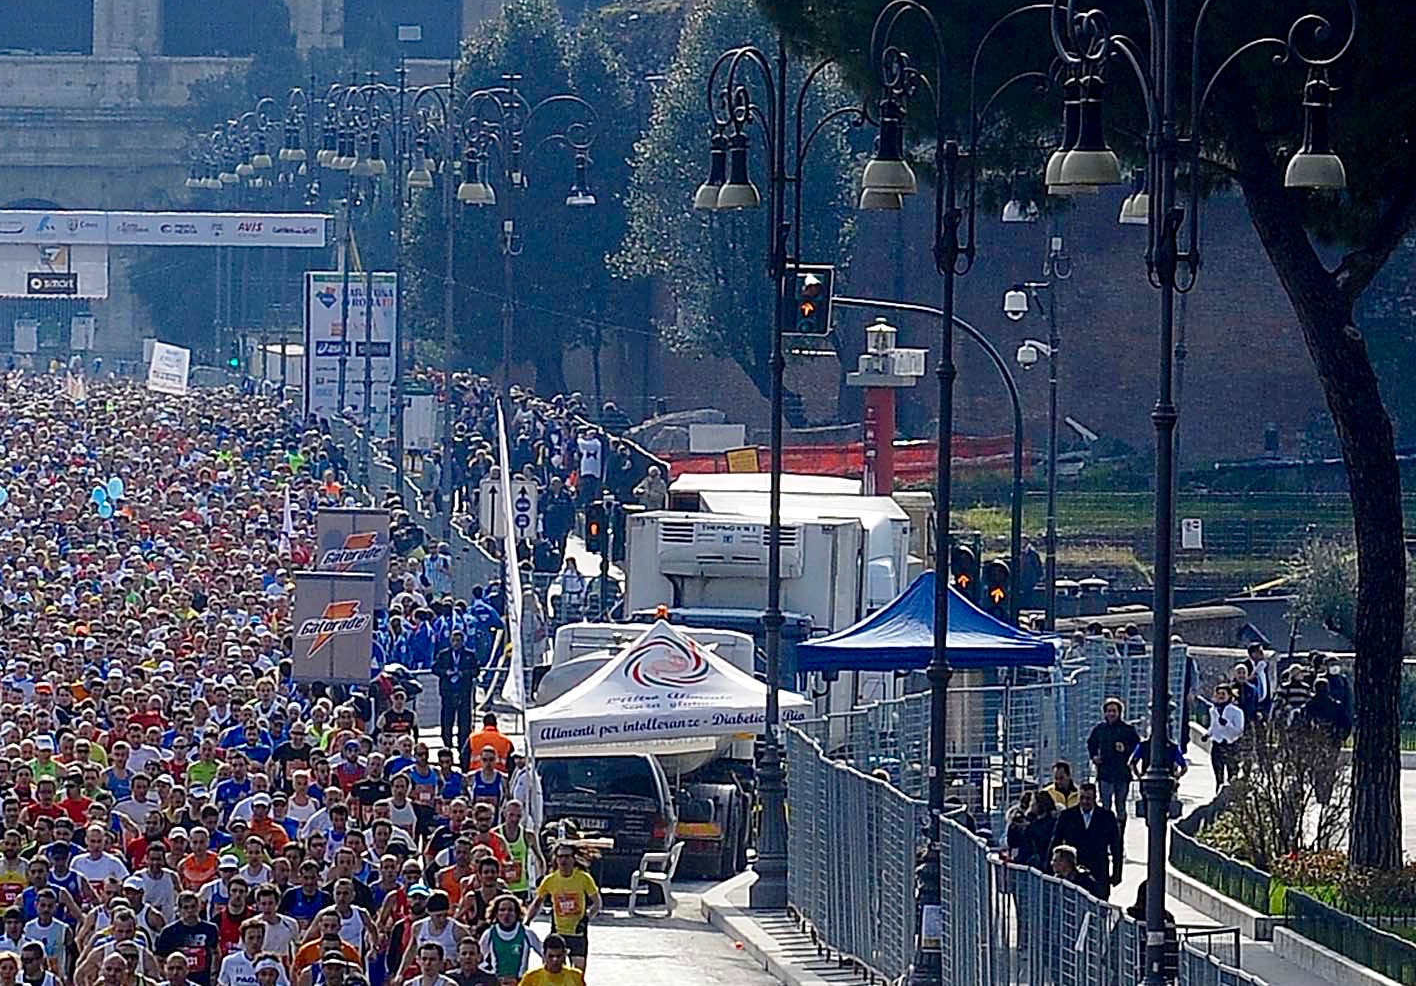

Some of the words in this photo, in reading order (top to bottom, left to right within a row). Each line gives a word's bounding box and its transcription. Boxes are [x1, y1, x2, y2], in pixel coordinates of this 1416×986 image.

[238, 221, 264, 232] AVIS
[43, 278, 74, 289] smart
[323, 547, 382, 565] Gatorade
[300, 617, 363, 636] Gatorade
[540, 723, 596, 741] Alimenti
[599, 725, 620, 739] per
[622, 717, 700, 733] intolleranze
[782, 708, 805, 723] Bio
